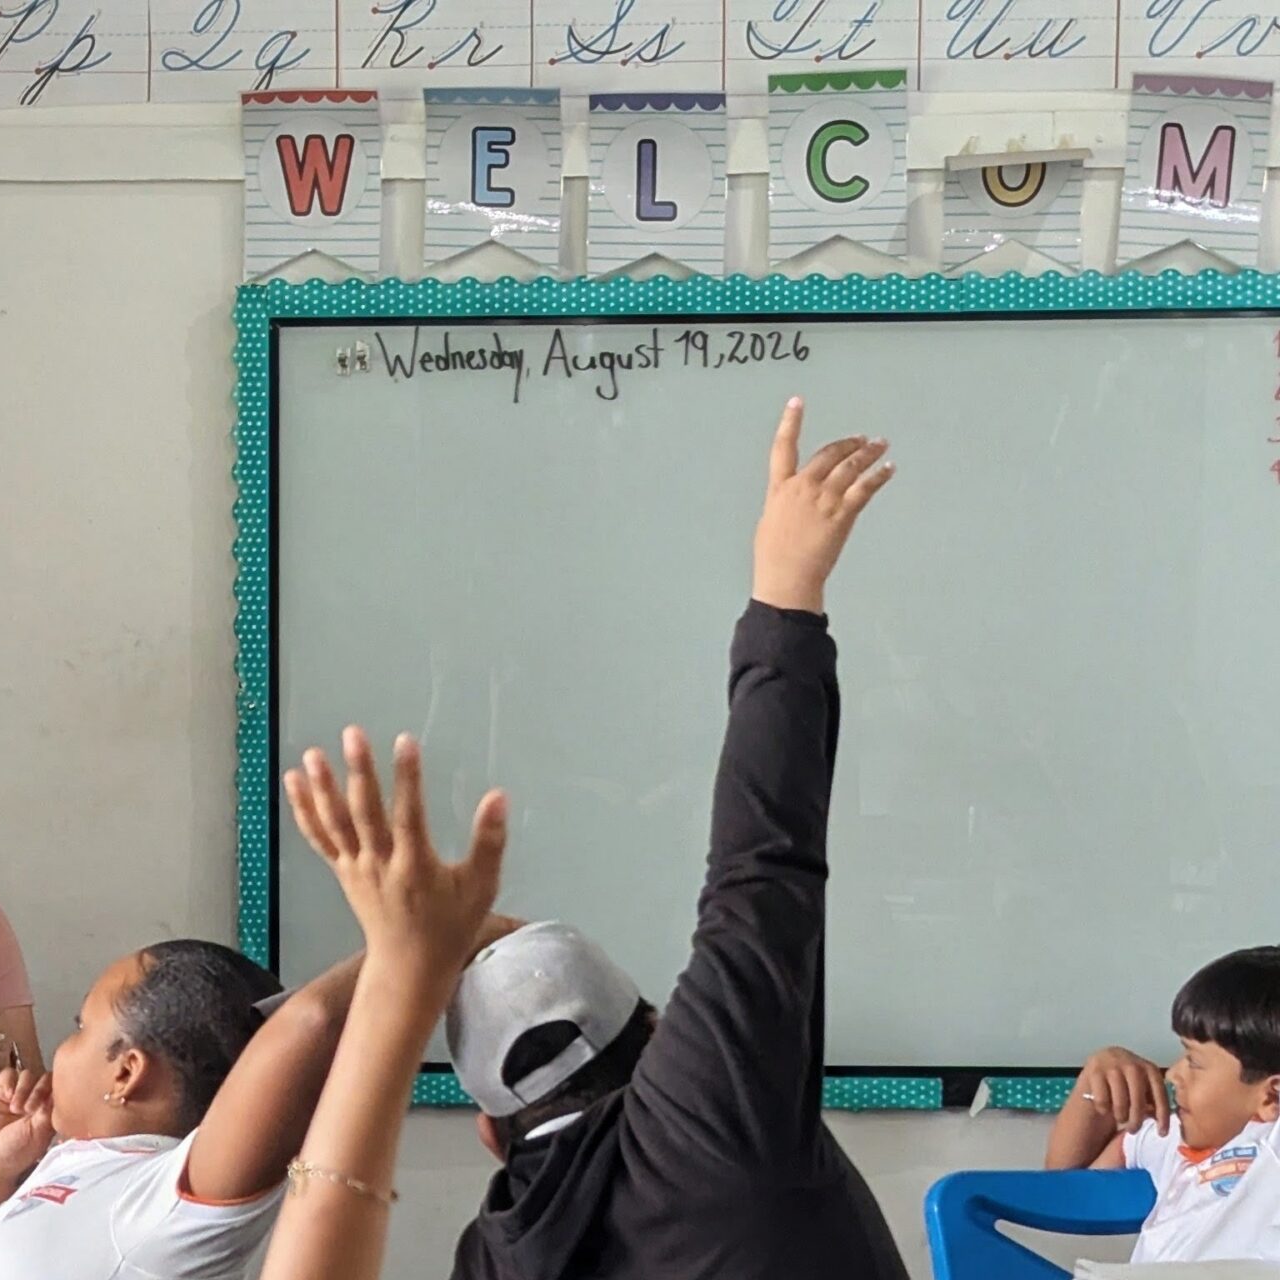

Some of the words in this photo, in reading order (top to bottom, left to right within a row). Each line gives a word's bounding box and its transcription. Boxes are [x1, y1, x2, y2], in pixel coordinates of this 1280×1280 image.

[161, 0, 311, 91] Qq
[360, 0, 503, 69] Rr
[550, 0, 686, 64] Ss
[946, 0, 1087, 59] Uu
[375, 325, 531, 405] Wednesday,
[542, 327, 665, 401] August
